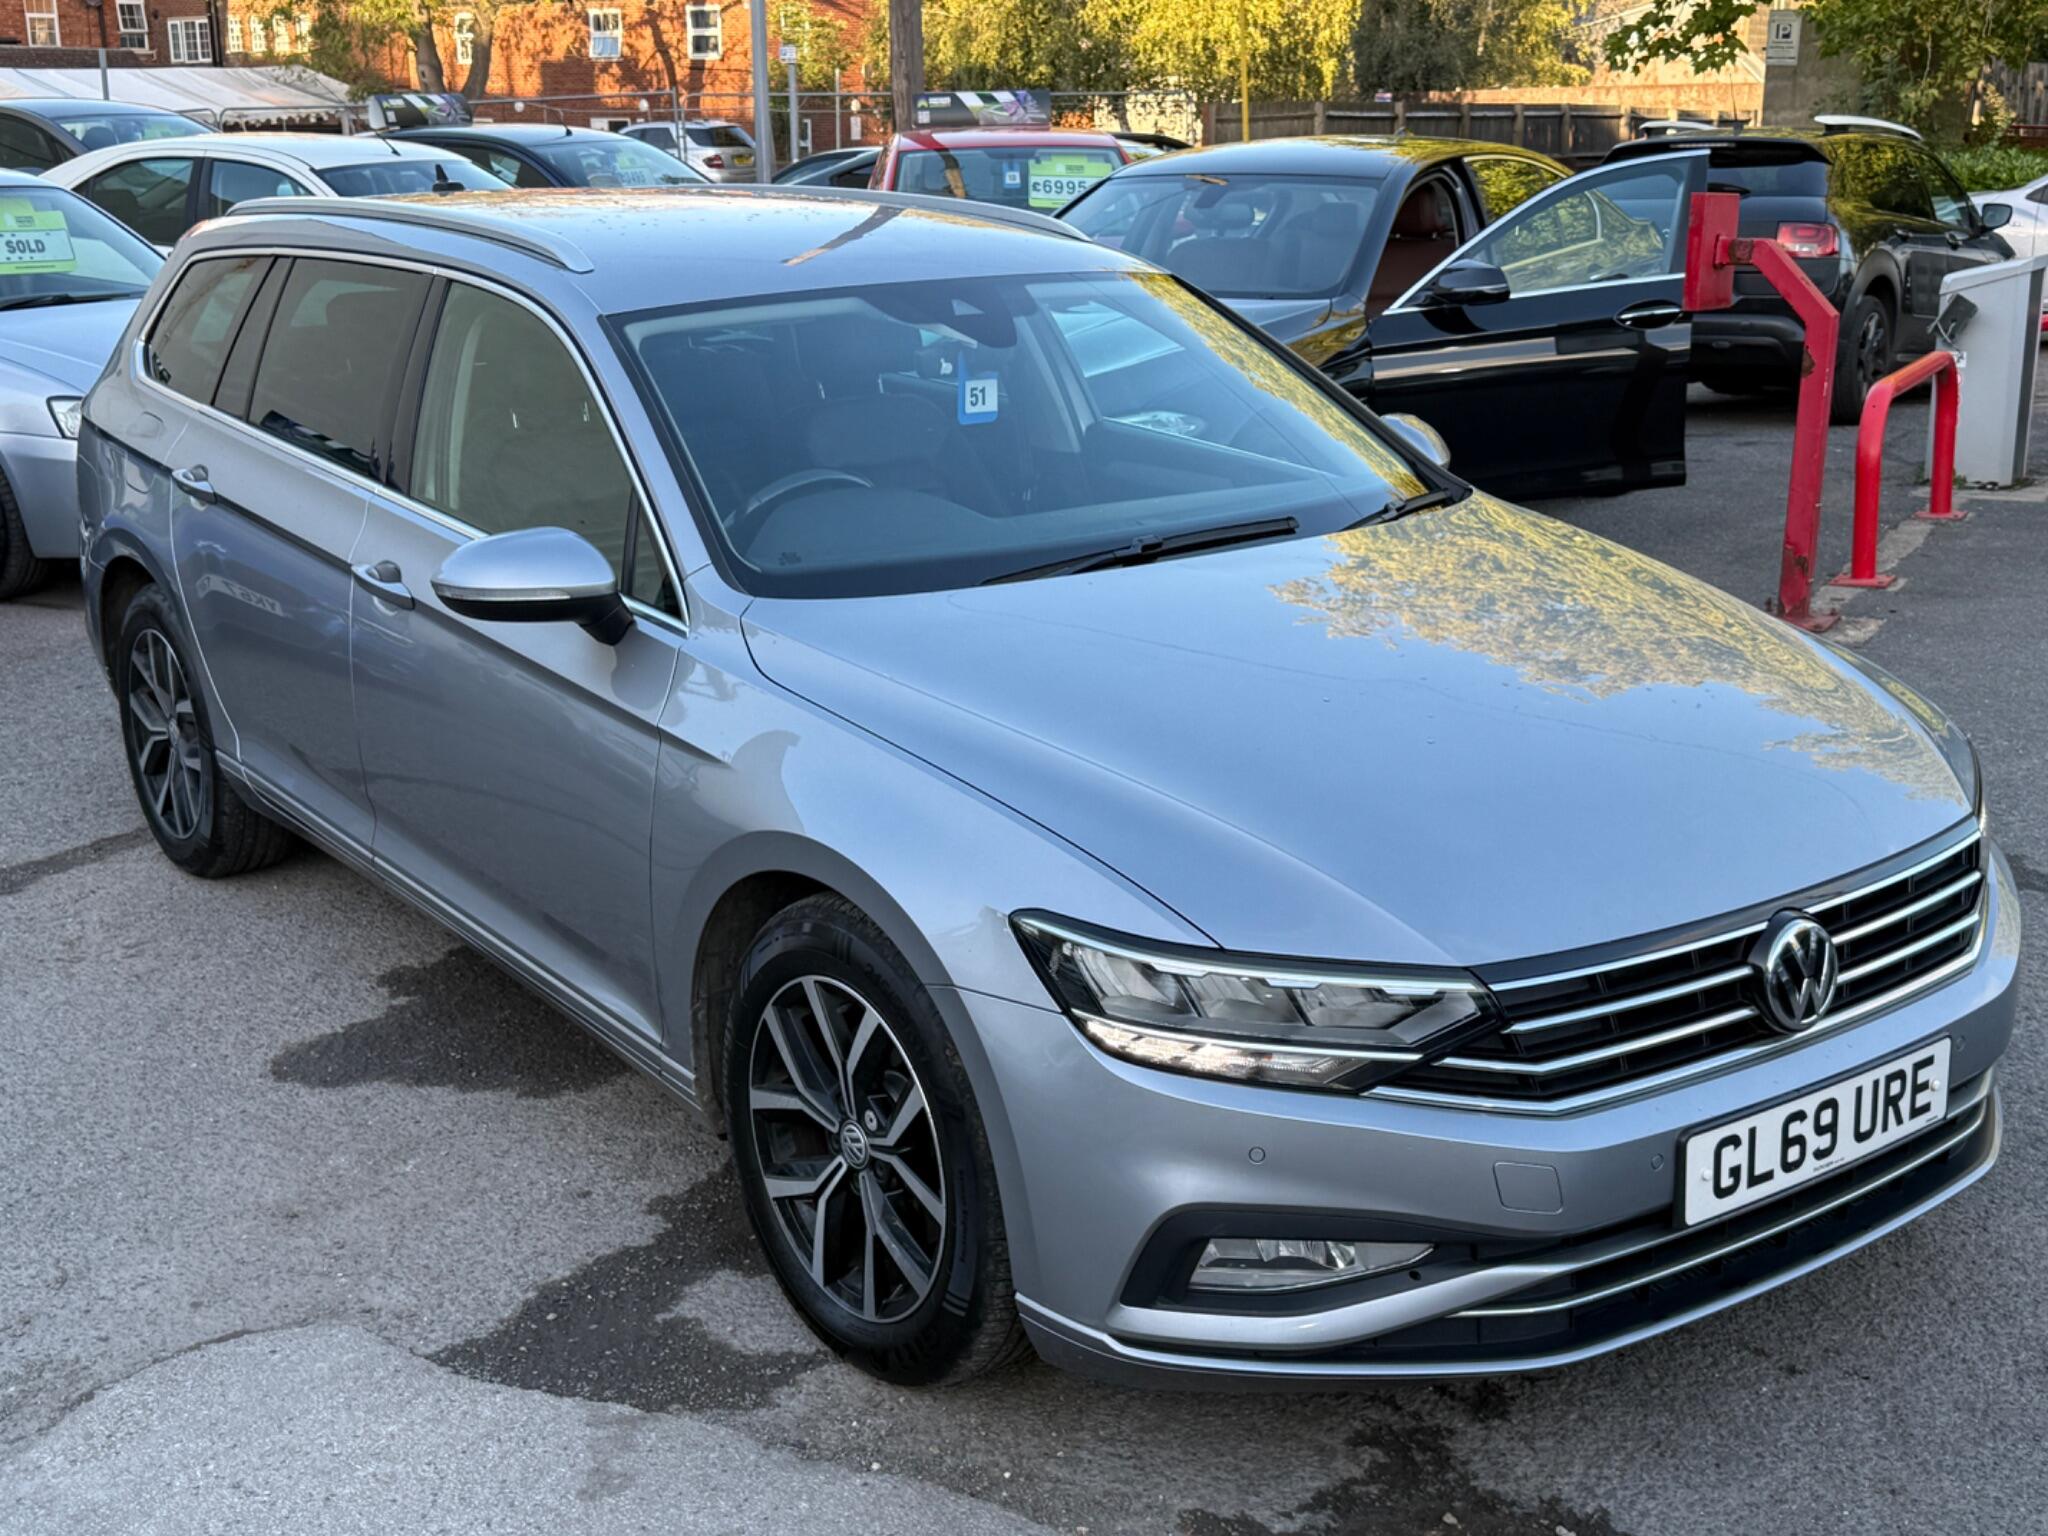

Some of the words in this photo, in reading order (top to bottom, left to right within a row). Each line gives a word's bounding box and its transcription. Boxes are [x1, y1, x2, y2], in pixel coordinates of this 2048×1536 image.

[1031, 180, 1087, 194] £6995
[5, 239, 45, 253] SOLD
[970, 386, 986, 407] 51
[1713, 1097, 1839, 1199] GL69
[1853, 1055, 1935, 1143] URE
